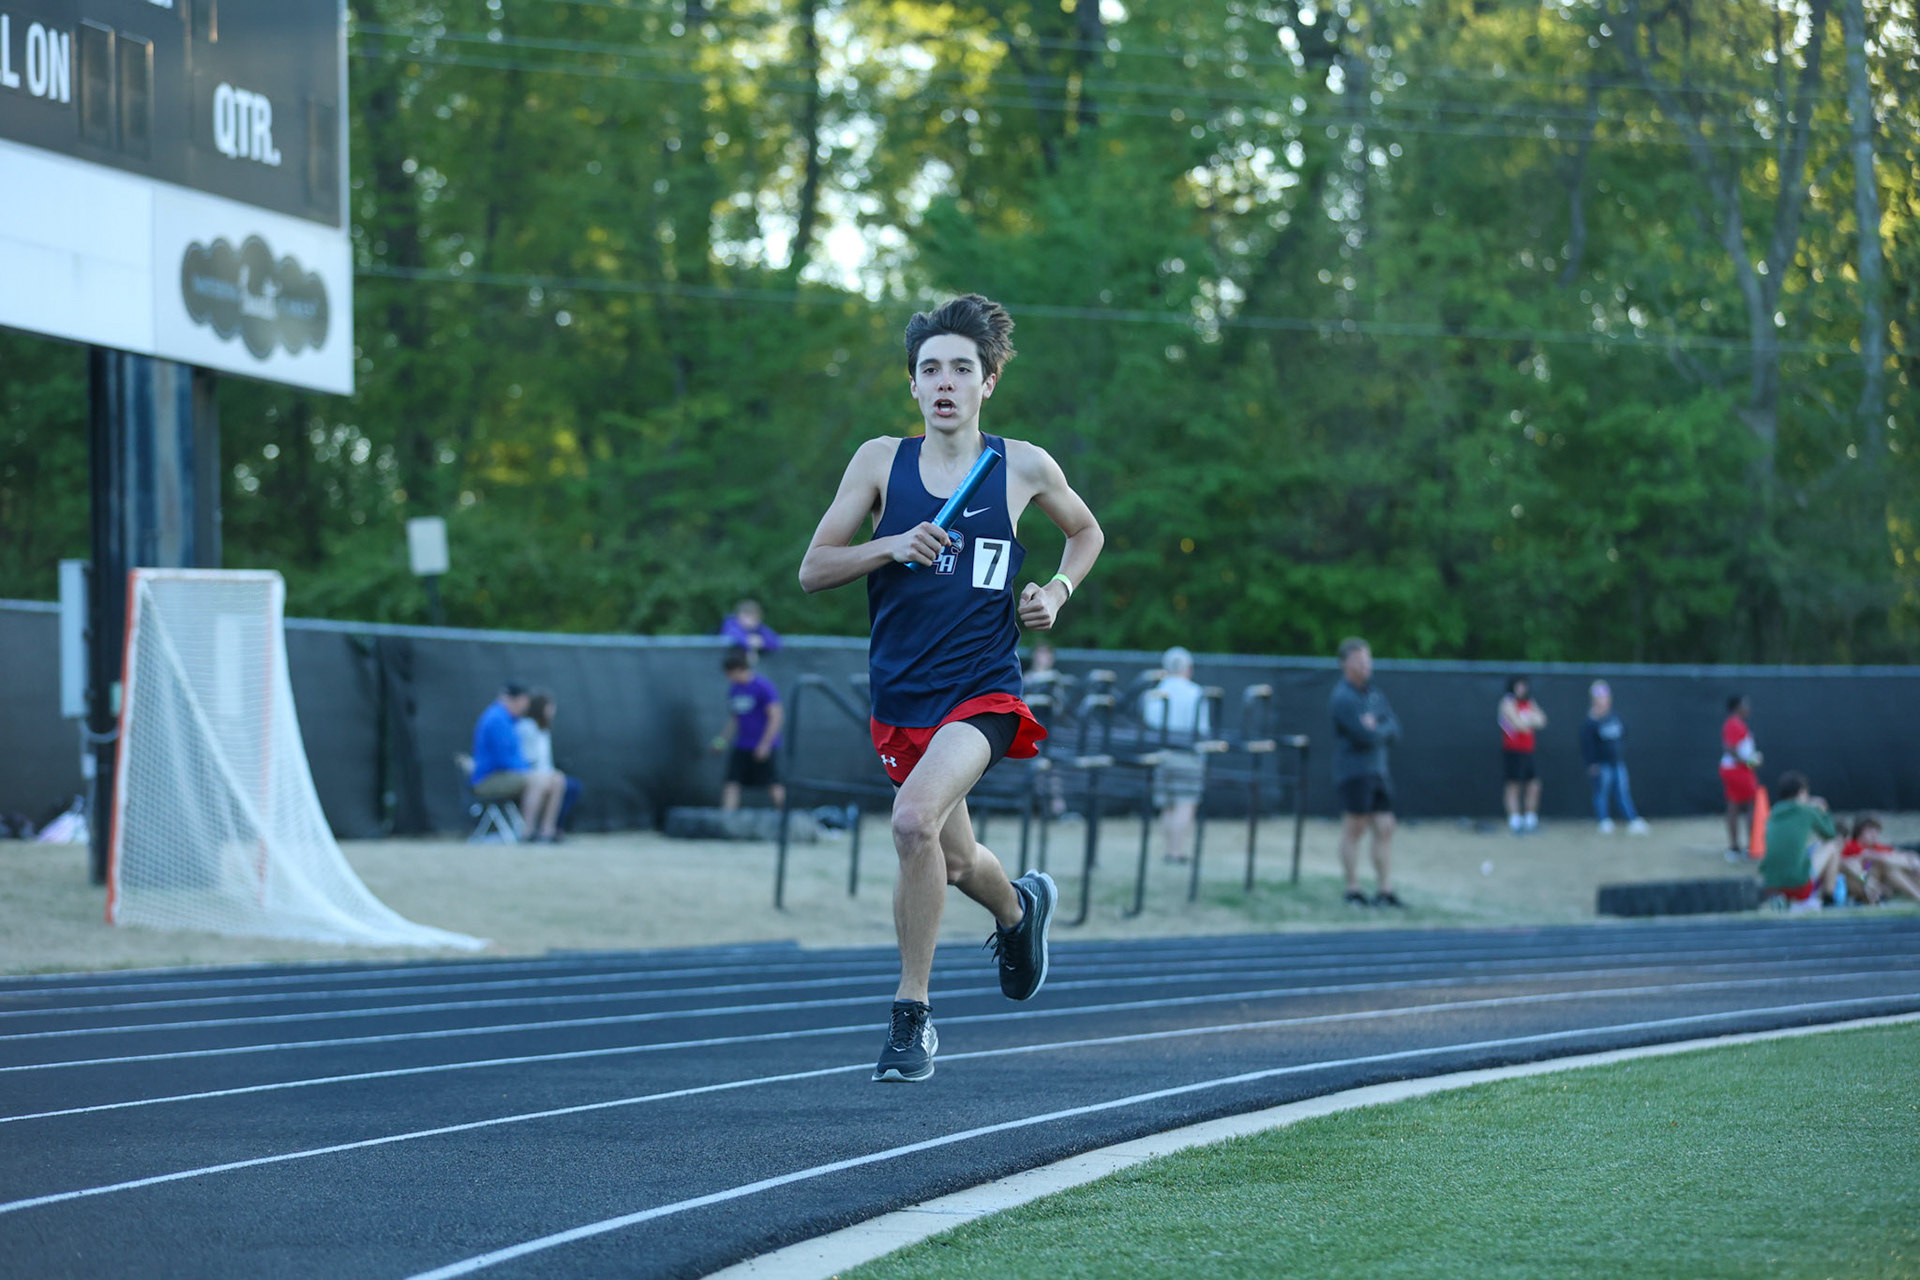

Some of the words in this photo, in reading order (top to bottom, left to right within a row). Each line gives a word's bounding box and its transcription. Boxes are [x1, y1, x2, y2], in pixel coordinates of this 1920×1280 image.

[0, 13, 20, 89] L
[26, 21, 71, 104] ON
[213, 81, 282, 167] QTR.
[982, 542, 1004, 586] 7
